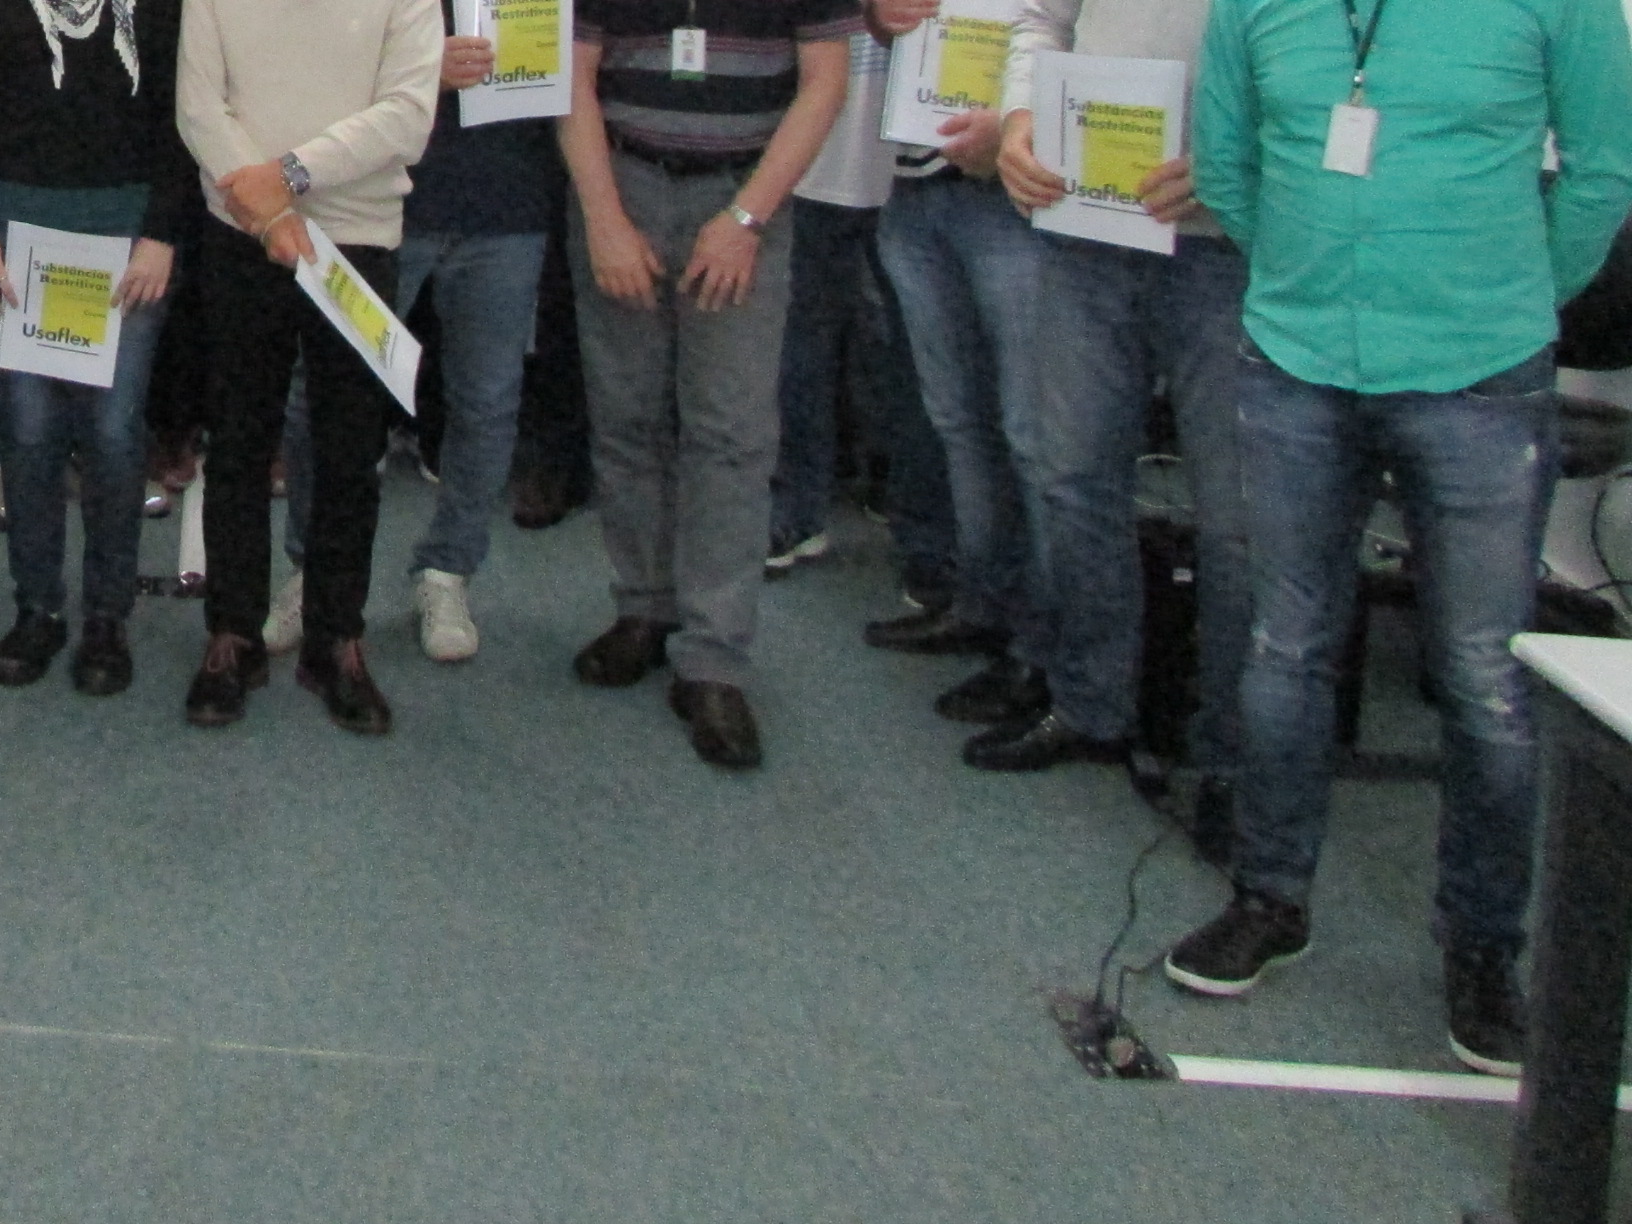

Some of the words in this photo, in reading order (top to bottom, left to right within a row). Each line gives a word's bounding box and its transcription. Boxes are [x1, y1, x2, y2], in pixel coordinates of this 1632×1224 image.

[490, 6, 559, 20] Restritivas
[40, 274, 111, 292] Restritivas
[23, 322, 92, 348] Usaflex
